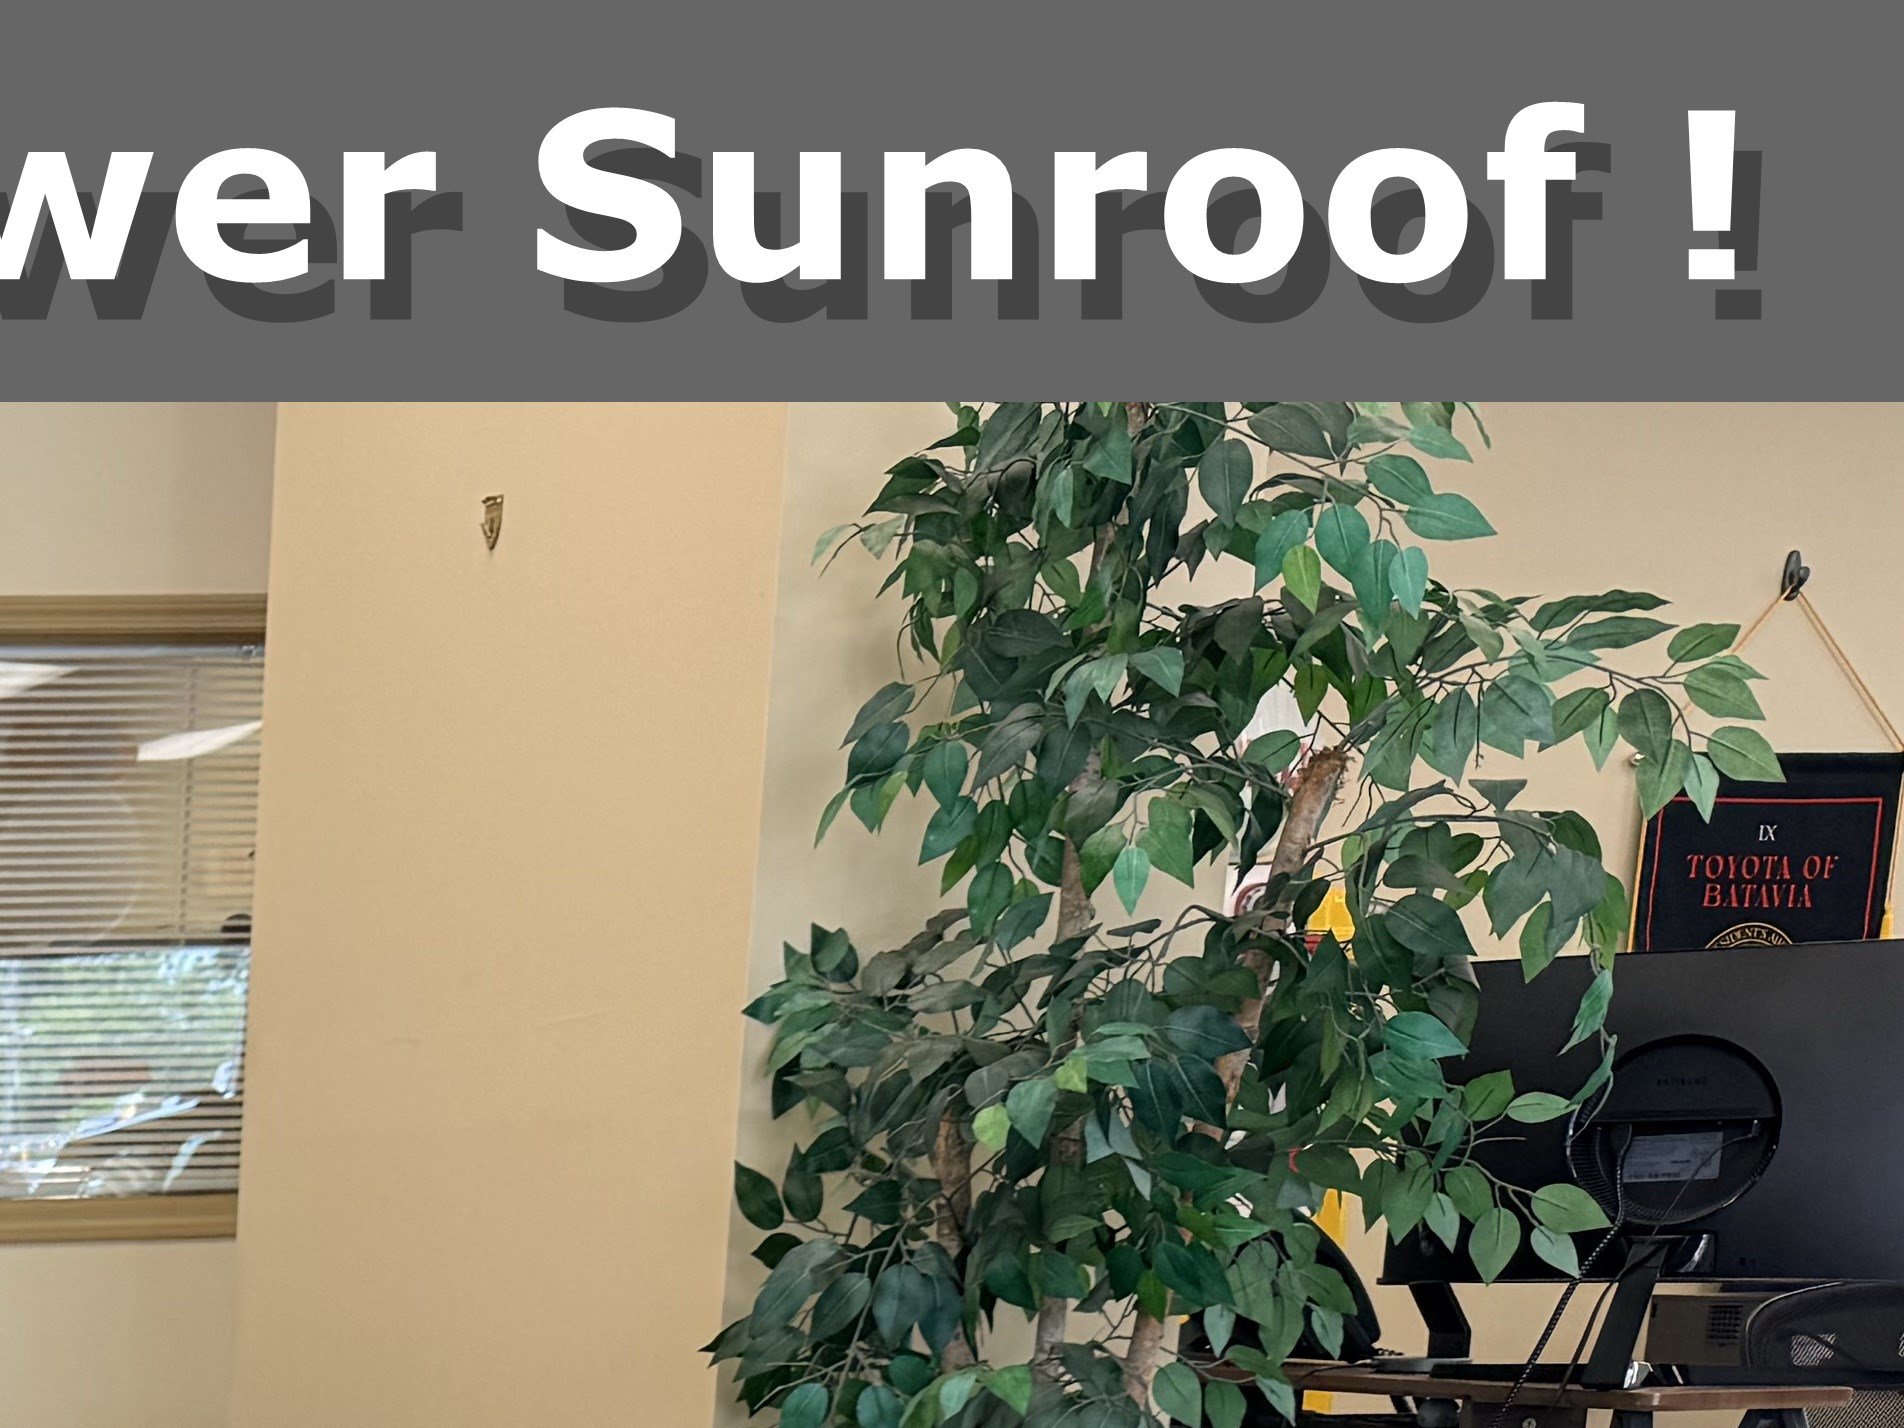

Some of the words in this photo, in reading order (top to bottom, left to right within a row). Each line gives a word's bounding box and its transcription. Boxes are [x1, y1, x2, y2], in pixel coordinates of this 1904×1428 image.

[1758, 824, 1778, 842] IX
[1686, 854, 1792, 881] TOYOTA
[1802, 855, 1839, 881] OF
[1702, 883, 1814, 909] BATAVIA
